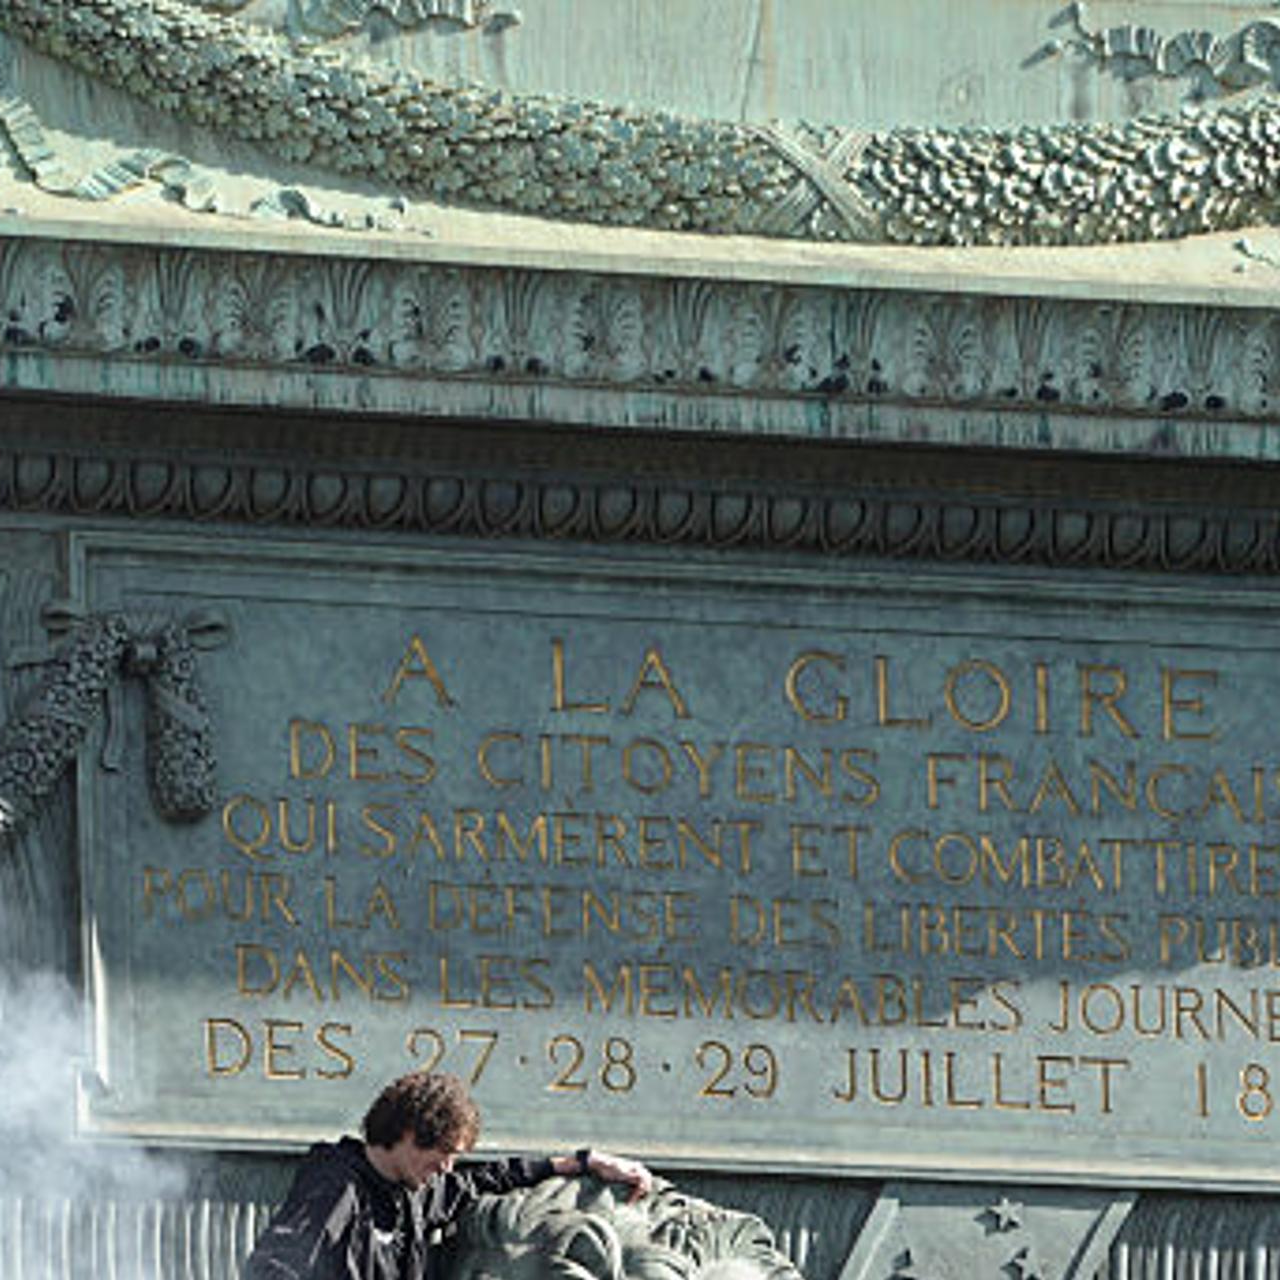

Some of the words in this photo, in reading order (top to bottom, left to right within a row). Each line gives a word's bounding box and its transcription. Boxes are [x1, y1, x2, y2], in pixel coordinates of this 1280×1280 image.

[380, 634, 457, 709] A
[548, 636, 694, 720] LA
[784, 650, 1224, 742] GLOIRE
[287, 718, 439, 786] DES
[477, 732, 881, 807] CITOYENS
[222, 797, 339, 862] QUI
[790, 822, 873, 881] ET
[141, 865, 300, 926] POUR
[324, 875, 401, 930] LA
[729, 893, 842, 950] DES
[863, 897, 1132, 964] LIBERTÉS
[234, 943, 411, 1003] DANS
[438, 953, 558, 1013] LES
[582, 946, 1024, 1034] MÉMORABLES
[204, 1017, 358, 1081] DES
[833, 1048, 1132, 1115] JUILLET
